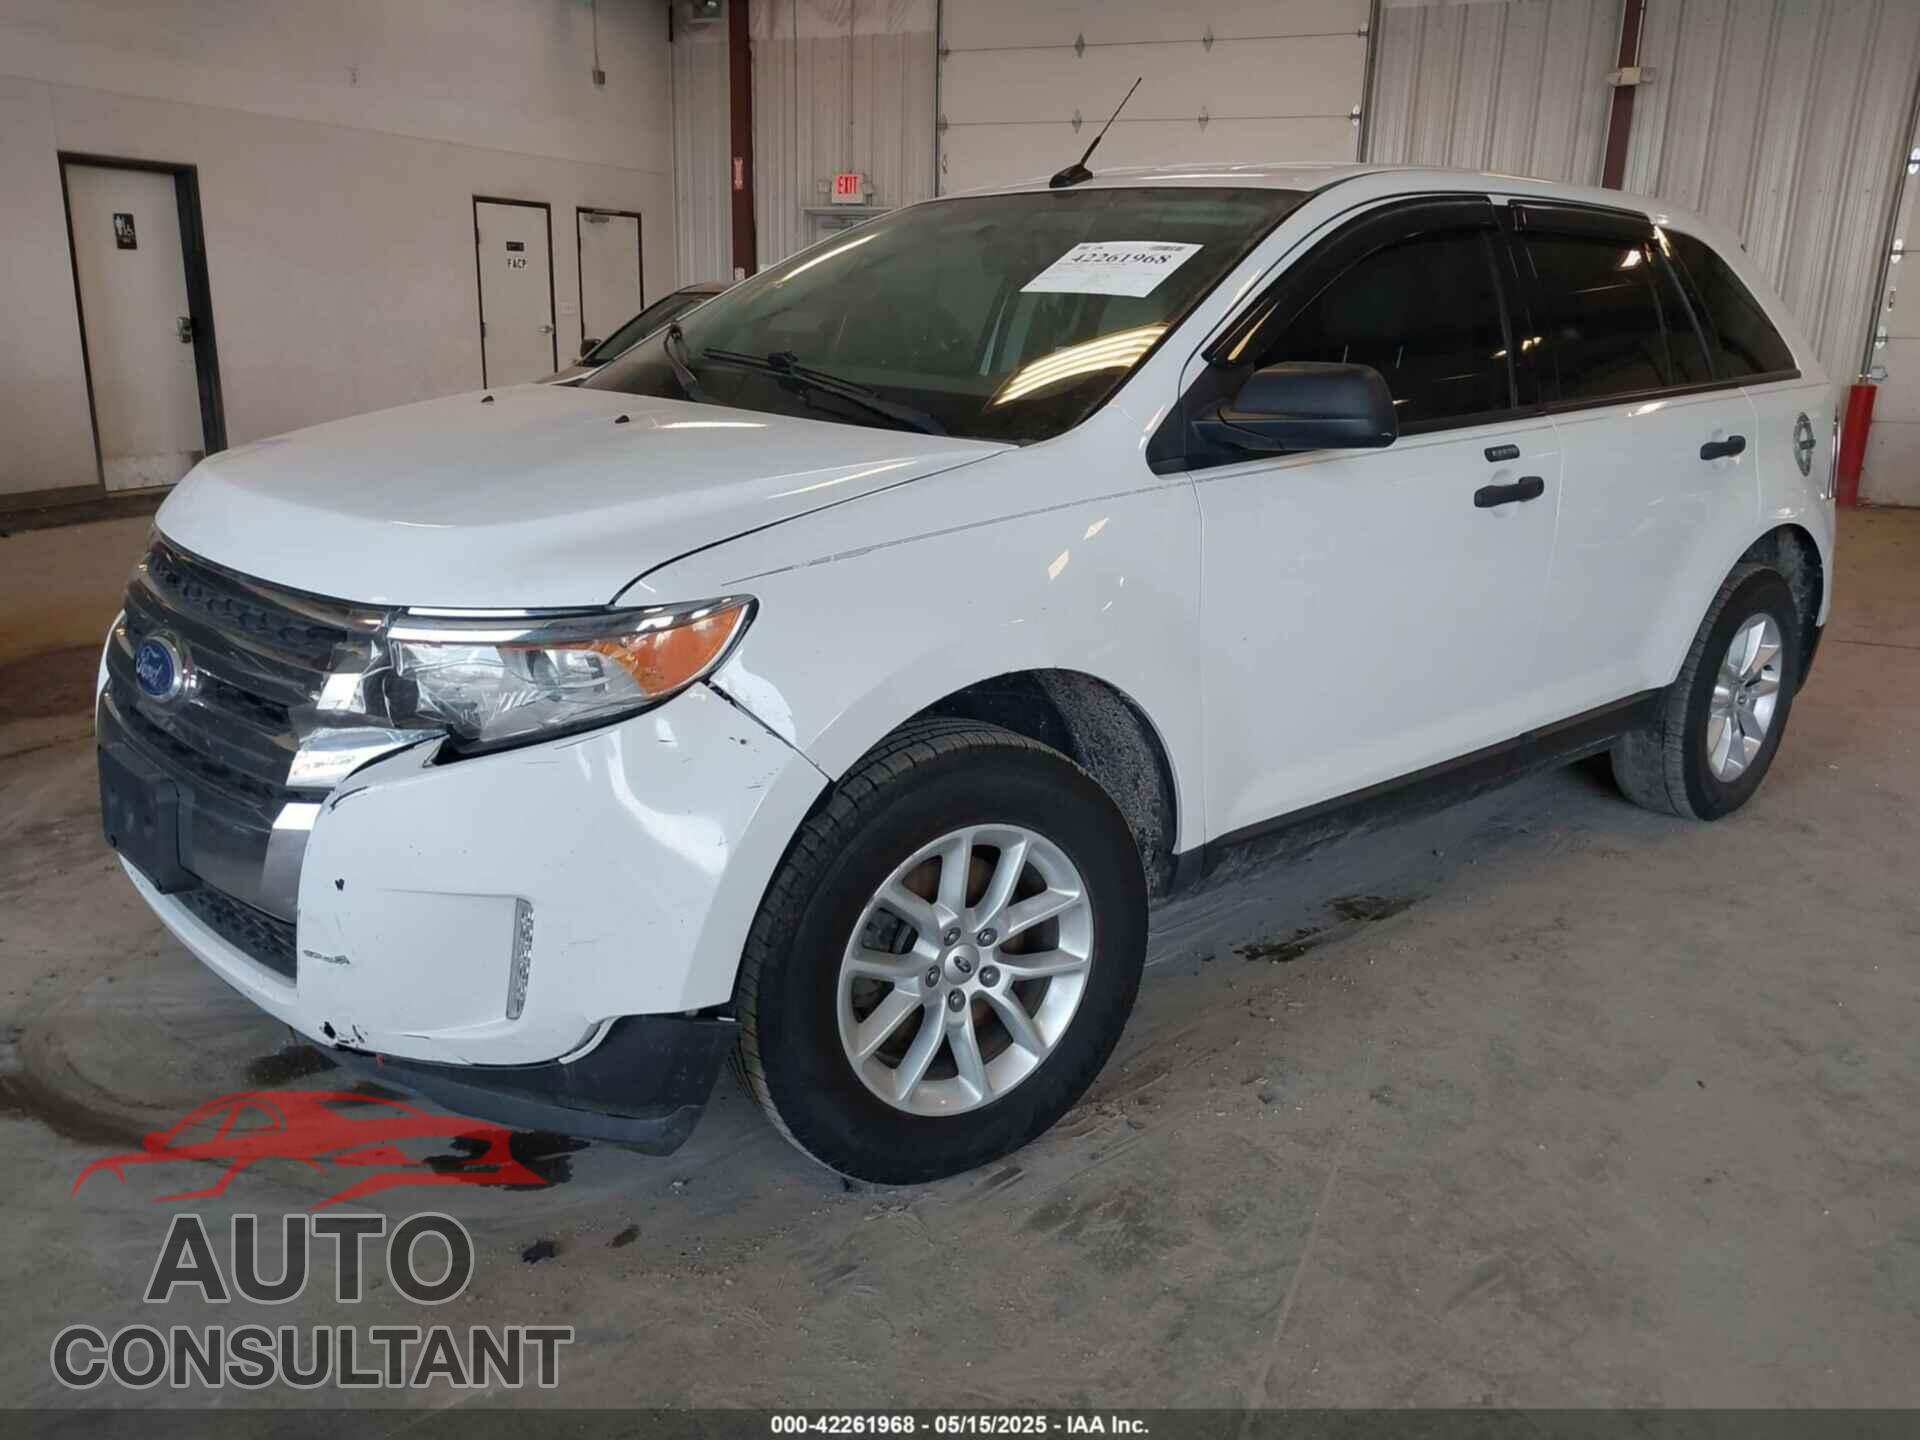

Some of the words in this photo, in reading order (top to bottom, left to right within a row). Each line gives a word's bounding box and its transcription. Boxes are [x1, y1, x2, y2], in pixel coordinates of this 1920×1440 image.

[837, 175, 857, 194] EXIT
[1072, 252, 1172, 264] 42261968
[136, 645, 163, 687] Ford
